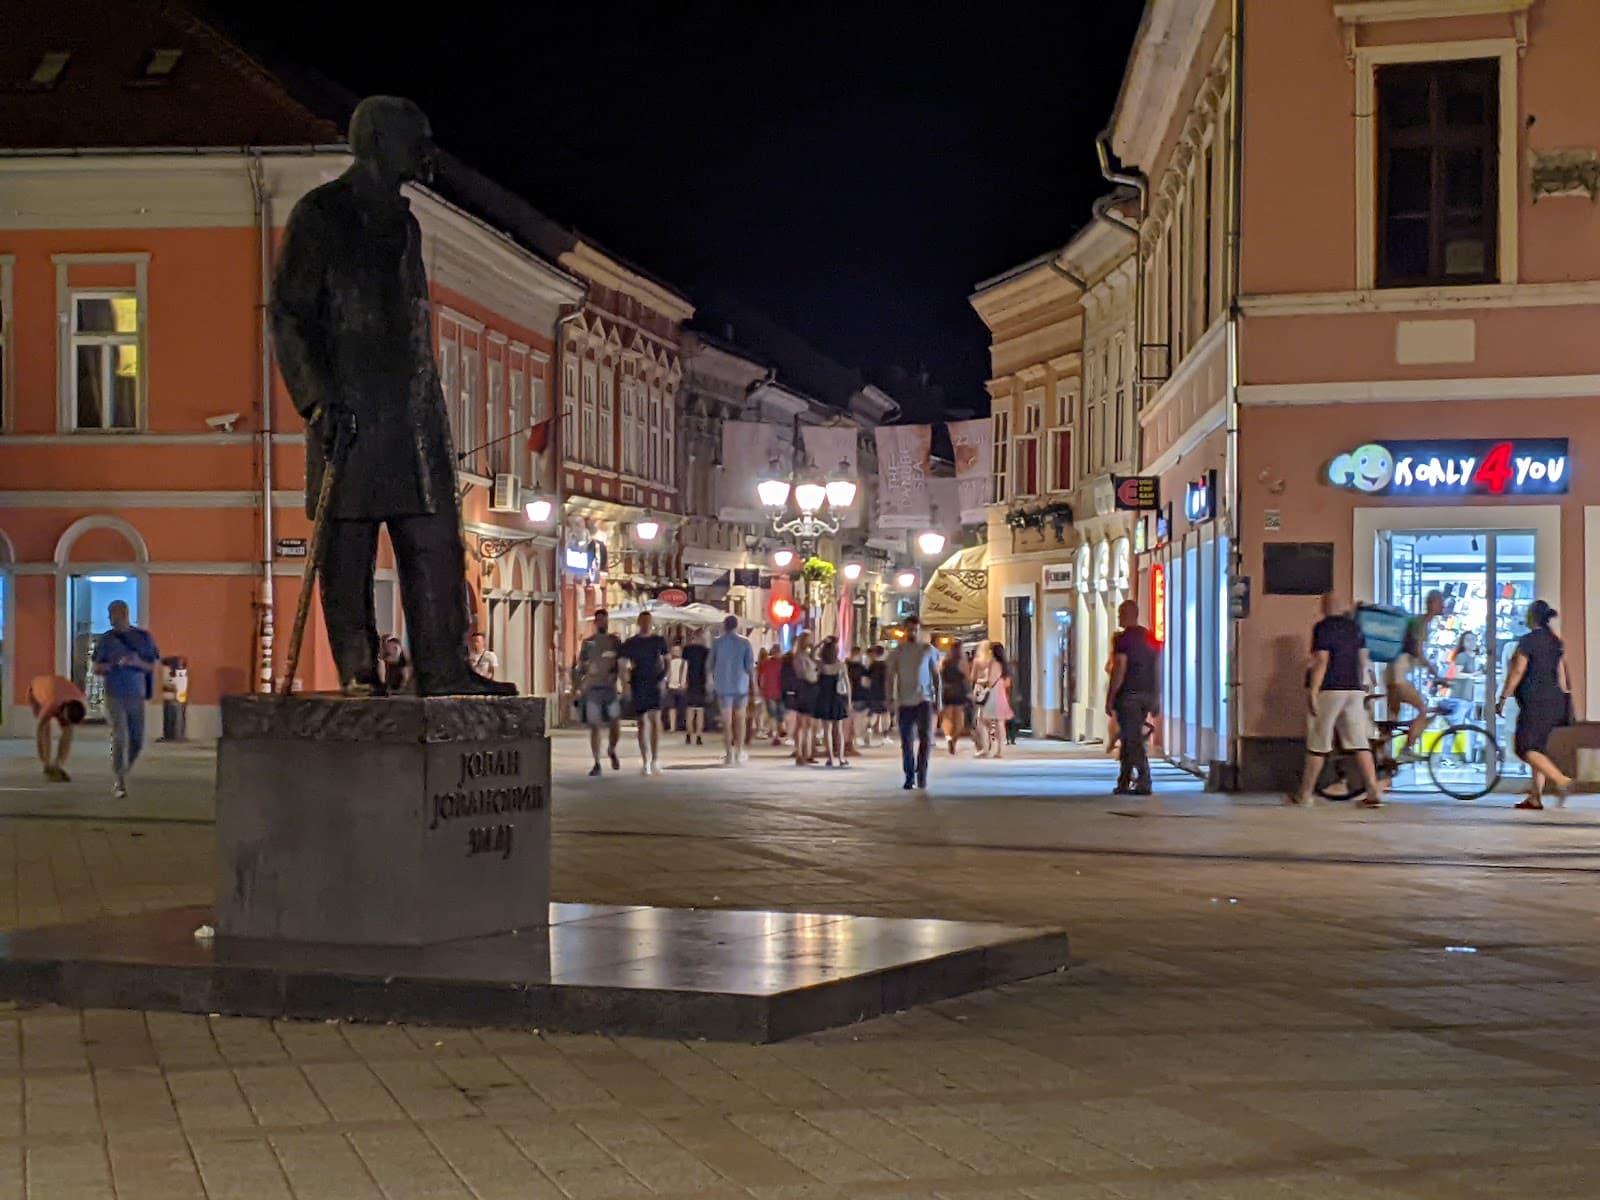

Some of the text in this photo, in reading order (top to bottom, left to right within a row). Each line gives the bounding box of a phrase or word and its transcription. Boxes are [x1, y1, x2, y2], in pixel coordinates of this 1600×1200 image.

[888, 453, 899, 489] THE
[900, 440, 912, 507] DANUBE
[912, 461, 925, 489] SEA
[1394, 442, 1565, 493] KOALY 4 YOU
